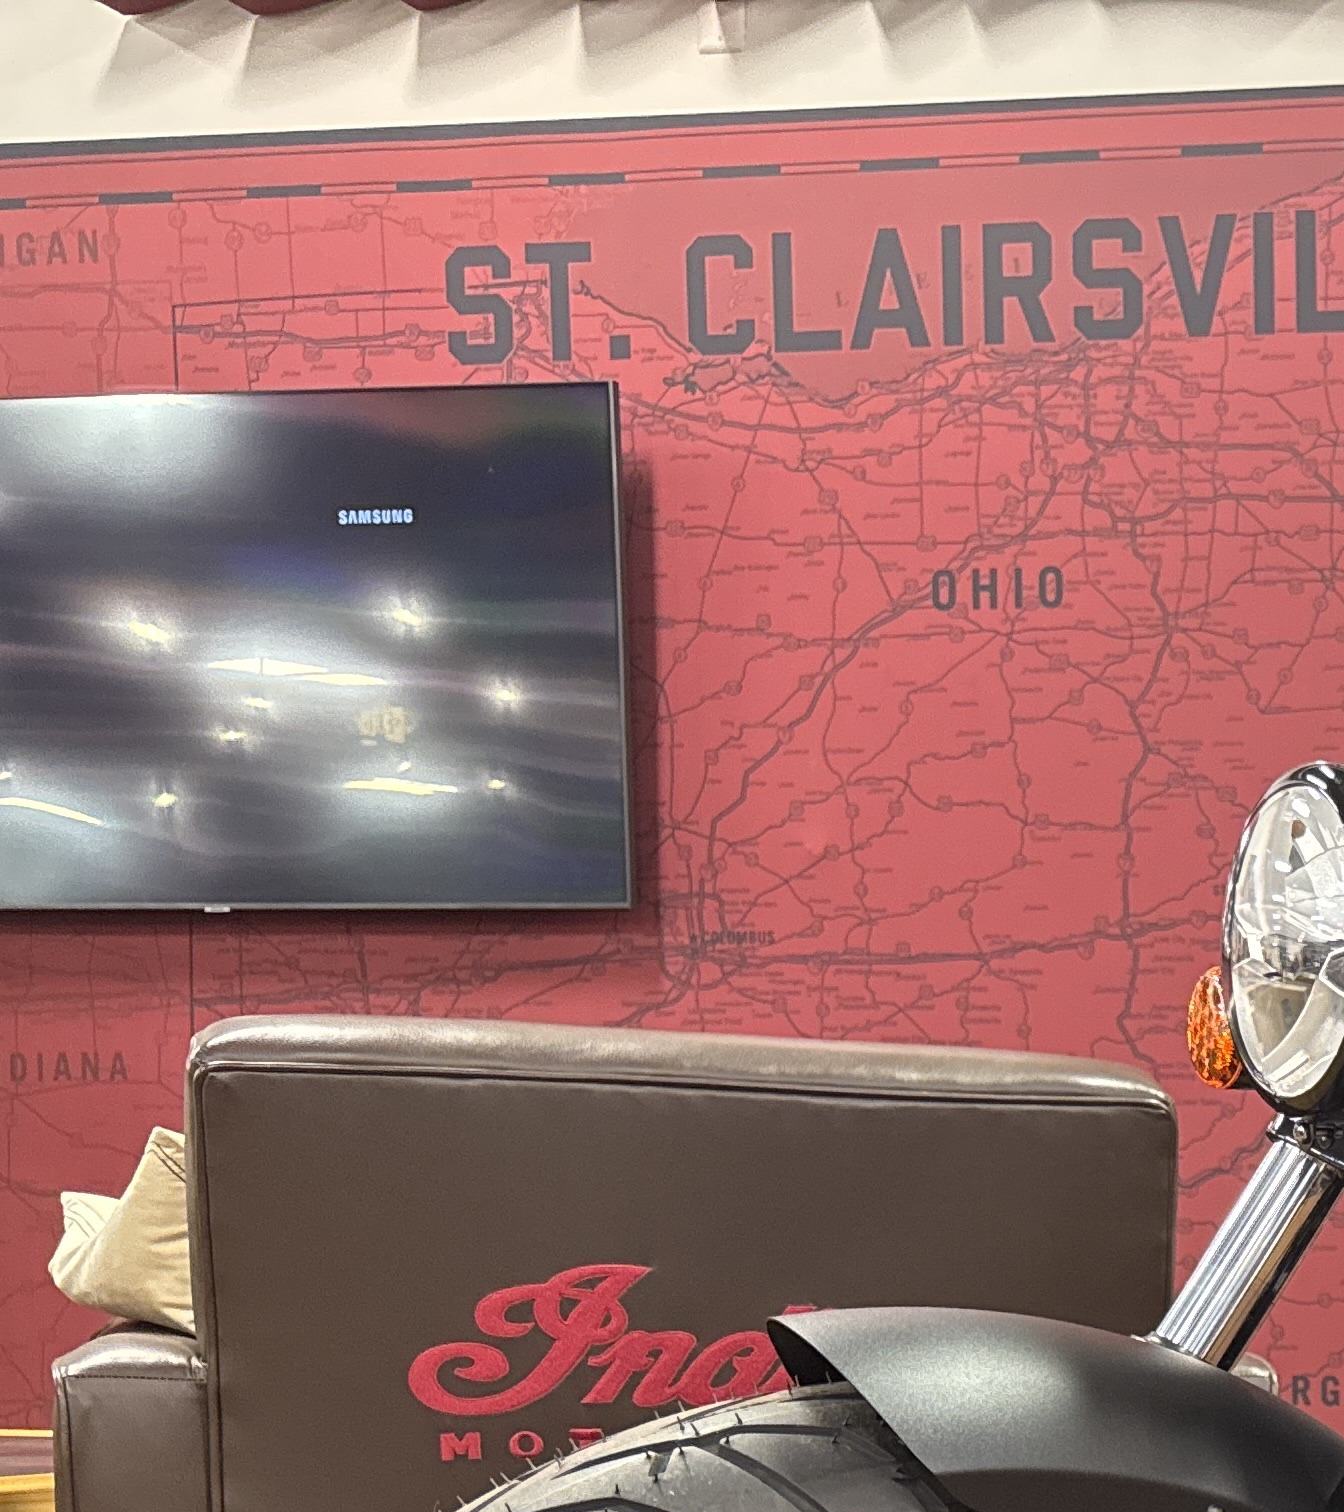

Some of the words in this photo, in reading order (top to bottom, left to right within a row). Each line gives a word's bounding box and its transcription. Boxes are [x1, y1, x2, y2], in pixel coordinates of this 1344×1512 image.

[445, 241, 632, 365] ST.
[338, 508, 414, 525] SAMSUNG
[931, 566, 1066, 611] OHIO
